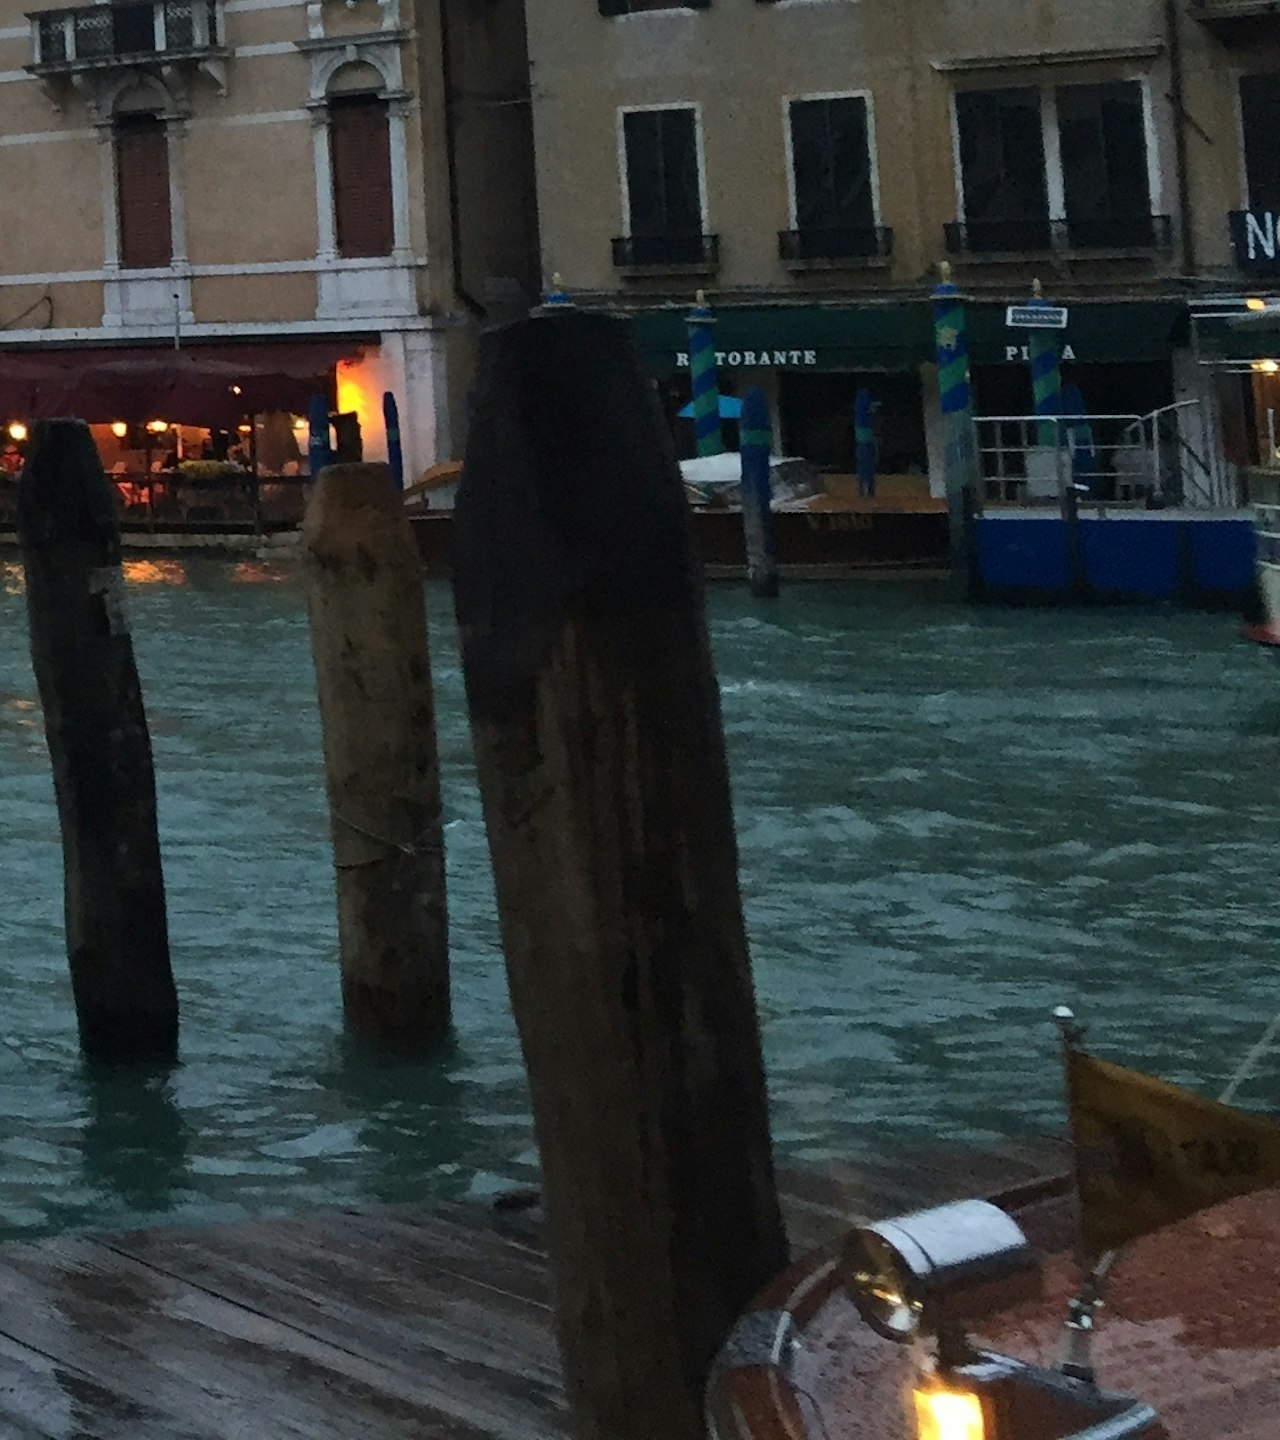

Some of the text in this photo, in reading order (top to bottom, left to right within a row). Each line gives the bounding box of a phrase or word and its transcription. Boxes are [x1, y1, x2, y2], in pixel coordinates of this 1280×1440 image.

[1245, 211, 1280, 259] N
[675, 349, 818, 367] RTORANTE
[1005, 344, 1076, 361] PIA
